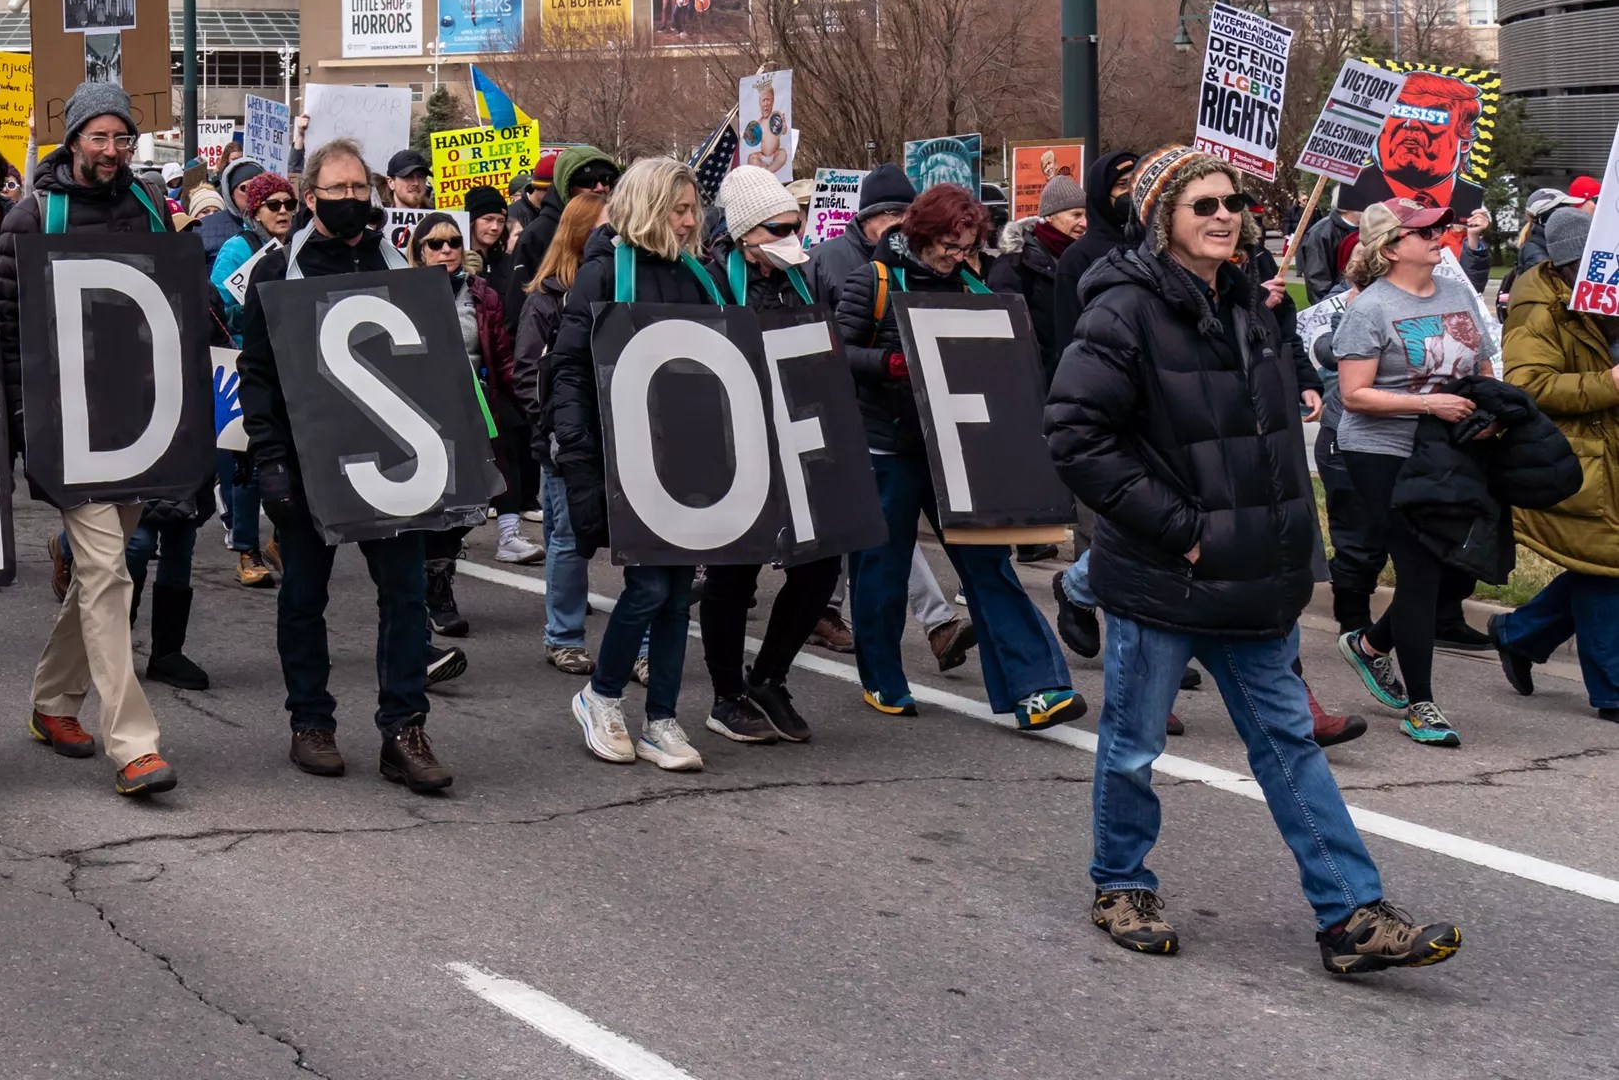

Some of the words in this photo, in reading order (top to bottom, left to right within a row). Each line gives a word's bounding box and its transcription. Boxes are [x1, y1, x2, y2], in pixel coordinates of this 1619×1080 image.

[352, 12, 412, 35] HORRORS
[1213, 11, 1287, 46] INTERNATIONAL
[1209, 35, 1285, 75] DEFEND
[1265, 39, 1287, 55] DAY
[1209, 52, 1283, 89] WOMEN'S
[1205, 67, 1219, 82] &
[1223, 71, 1281, 105] LGBTQ
[1340, 68, 1399, 103] VICTORY
[13, 101, 24, 112] to
[247, 95, 265, 112] WHEN
[264, 99, 274, 114] THE
[317, 92, 345, 117] NO
[354, 94, 403, 116] WAR
[1350, 92, 1360, 104] TO
[1361, 95, 1373, 108] THE
[251, 109, 265, 127] HAVE
[265, 114, 289, 132] NOTHING
[1199, 81, 1280, 151] RIGHTS
[1390, 103, 1449, 125] RESIST
[197, 122, 233, 134] TRUMP
[247, 123, 263, 140] MORE
[264, 128, 271, 142] TO
[273, 129, 284, 146] EAT
[435, 129, 495, 150] HANDS
[500, 125, 533, 140] OFF
[1315, 118, 1377, 149] PALESTINIAN
[197, 145, 223, 157] MOB
[250, 138, 266, 155] THEY
[268, 143, 283, 162] WILL
[447, 147, 483, 162] OUR
[488, 140, 531, 157] LIFE,
[1307, 135, 1369, 166] RESISTANCE
[441, 157, 512, 179] LIBERTY
[518, 154, 531, 167] &
[825, 170, 860, 184] Science
[440, 171, 512, 194] PURSUIT
[830, 184, 859, 193] HUMAN
[1574, 280, 1619, 316] RES
